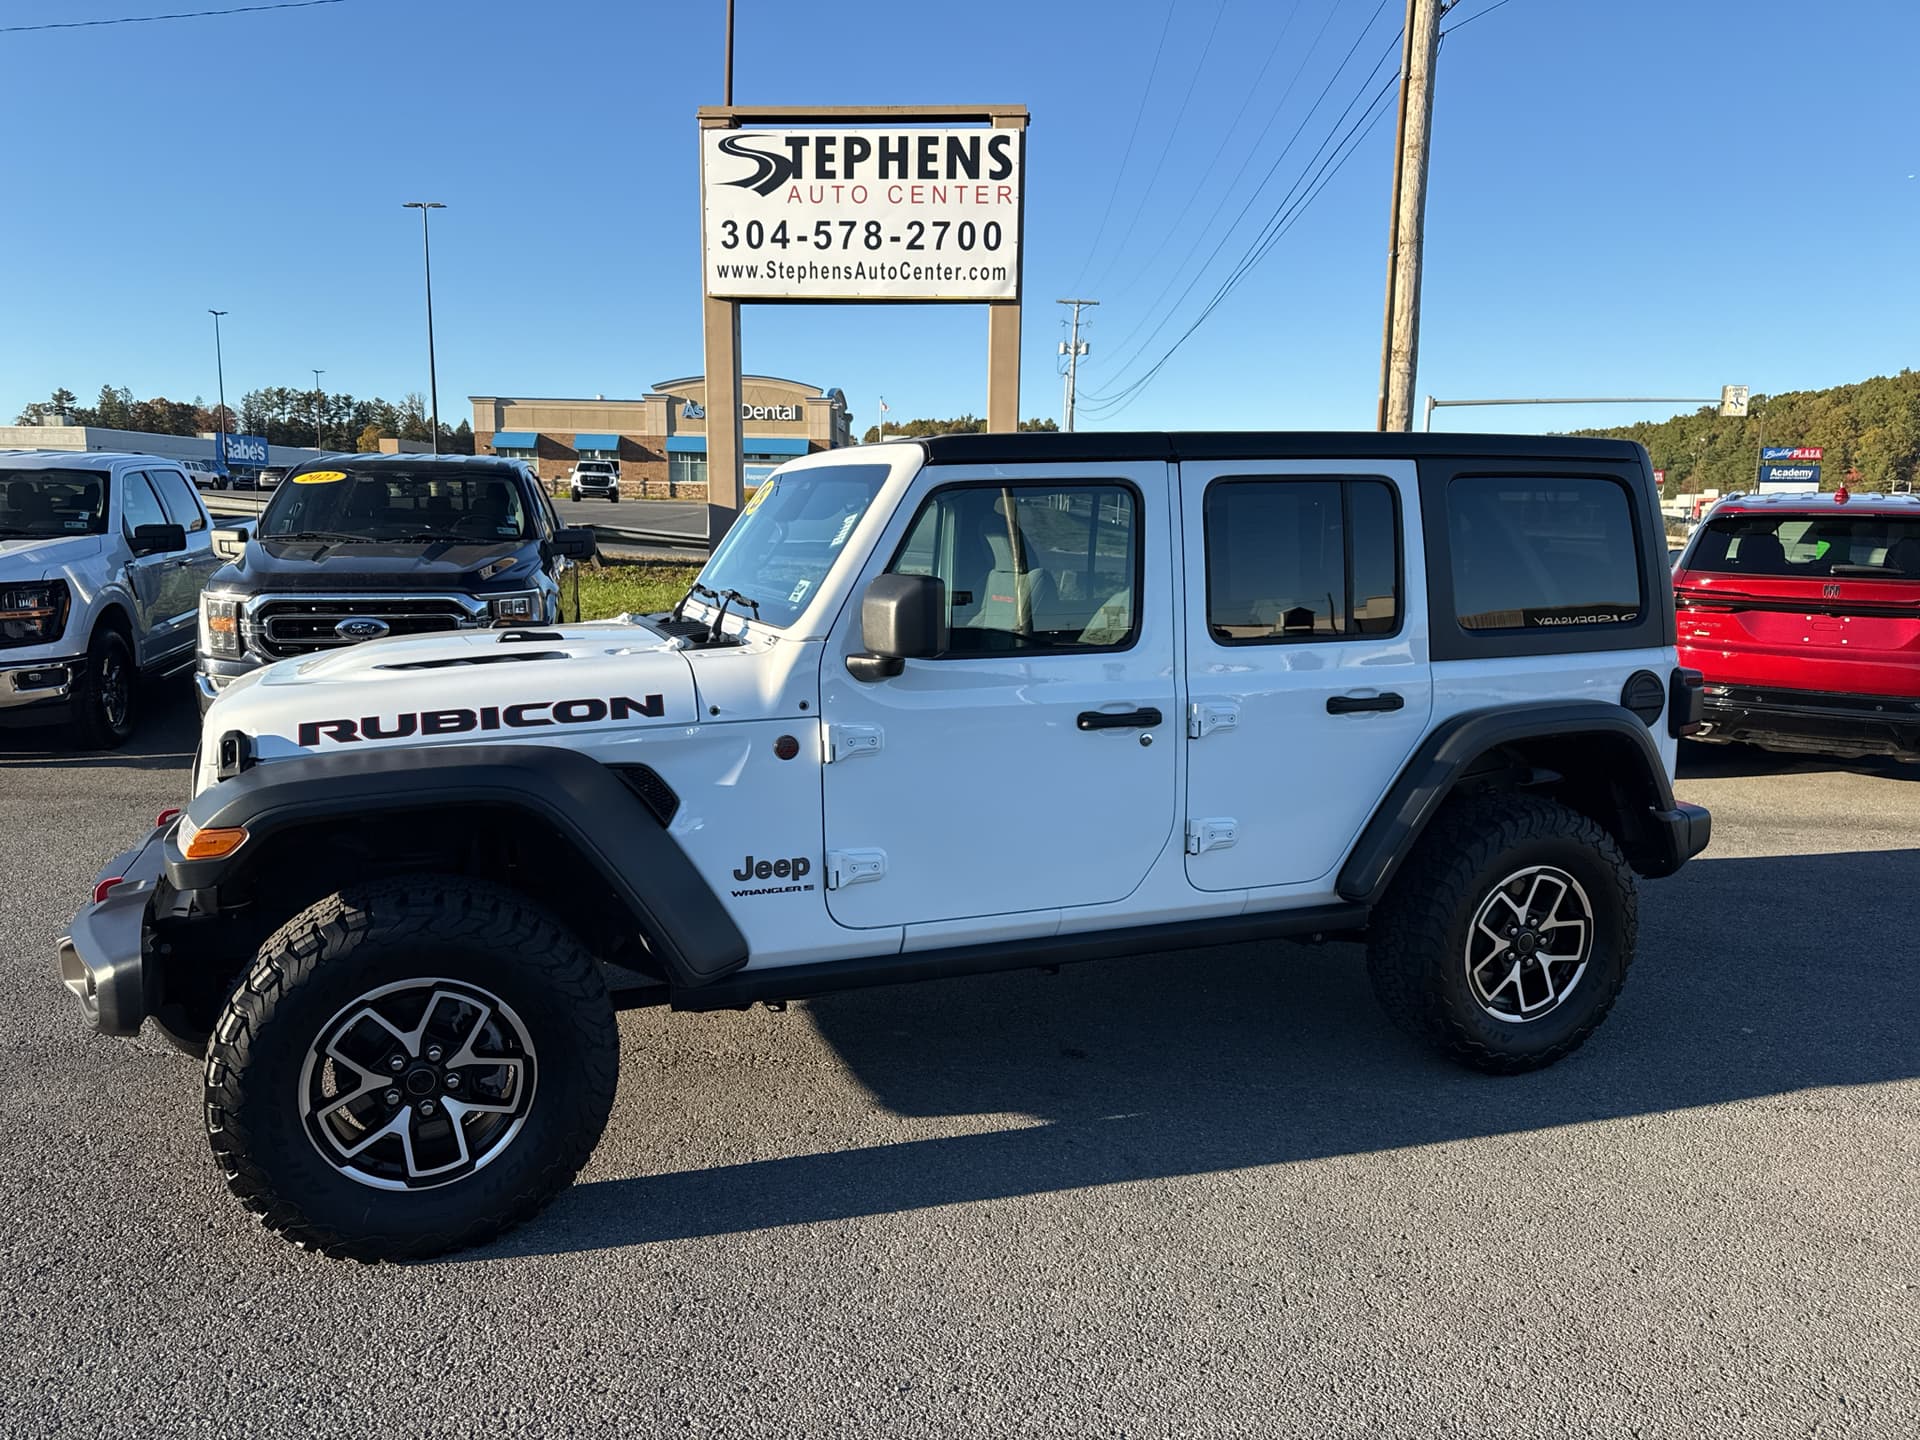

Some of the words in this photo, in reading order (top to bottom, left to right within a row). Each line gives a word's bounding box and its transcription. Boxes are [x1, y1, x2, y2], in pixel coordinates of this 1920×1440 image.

[787, 185, 868, 204] AUTO
[888, 185, 1013, 205] CENTER
[720, 219, 1002, 251] 304-578-2700
[717, 260, 1007, 284] www.StephensAutoCenter.com
[741, 404, 796, 420] Dental
[1793, 449, 1822, 458] PLAZA
[1770, 467, 1814, 479] Academy
[298, 693, 665, 748] RUBICON
[733, 855, 811, 881] Jeep
[731, 885, 802, 898] WRANGLER
